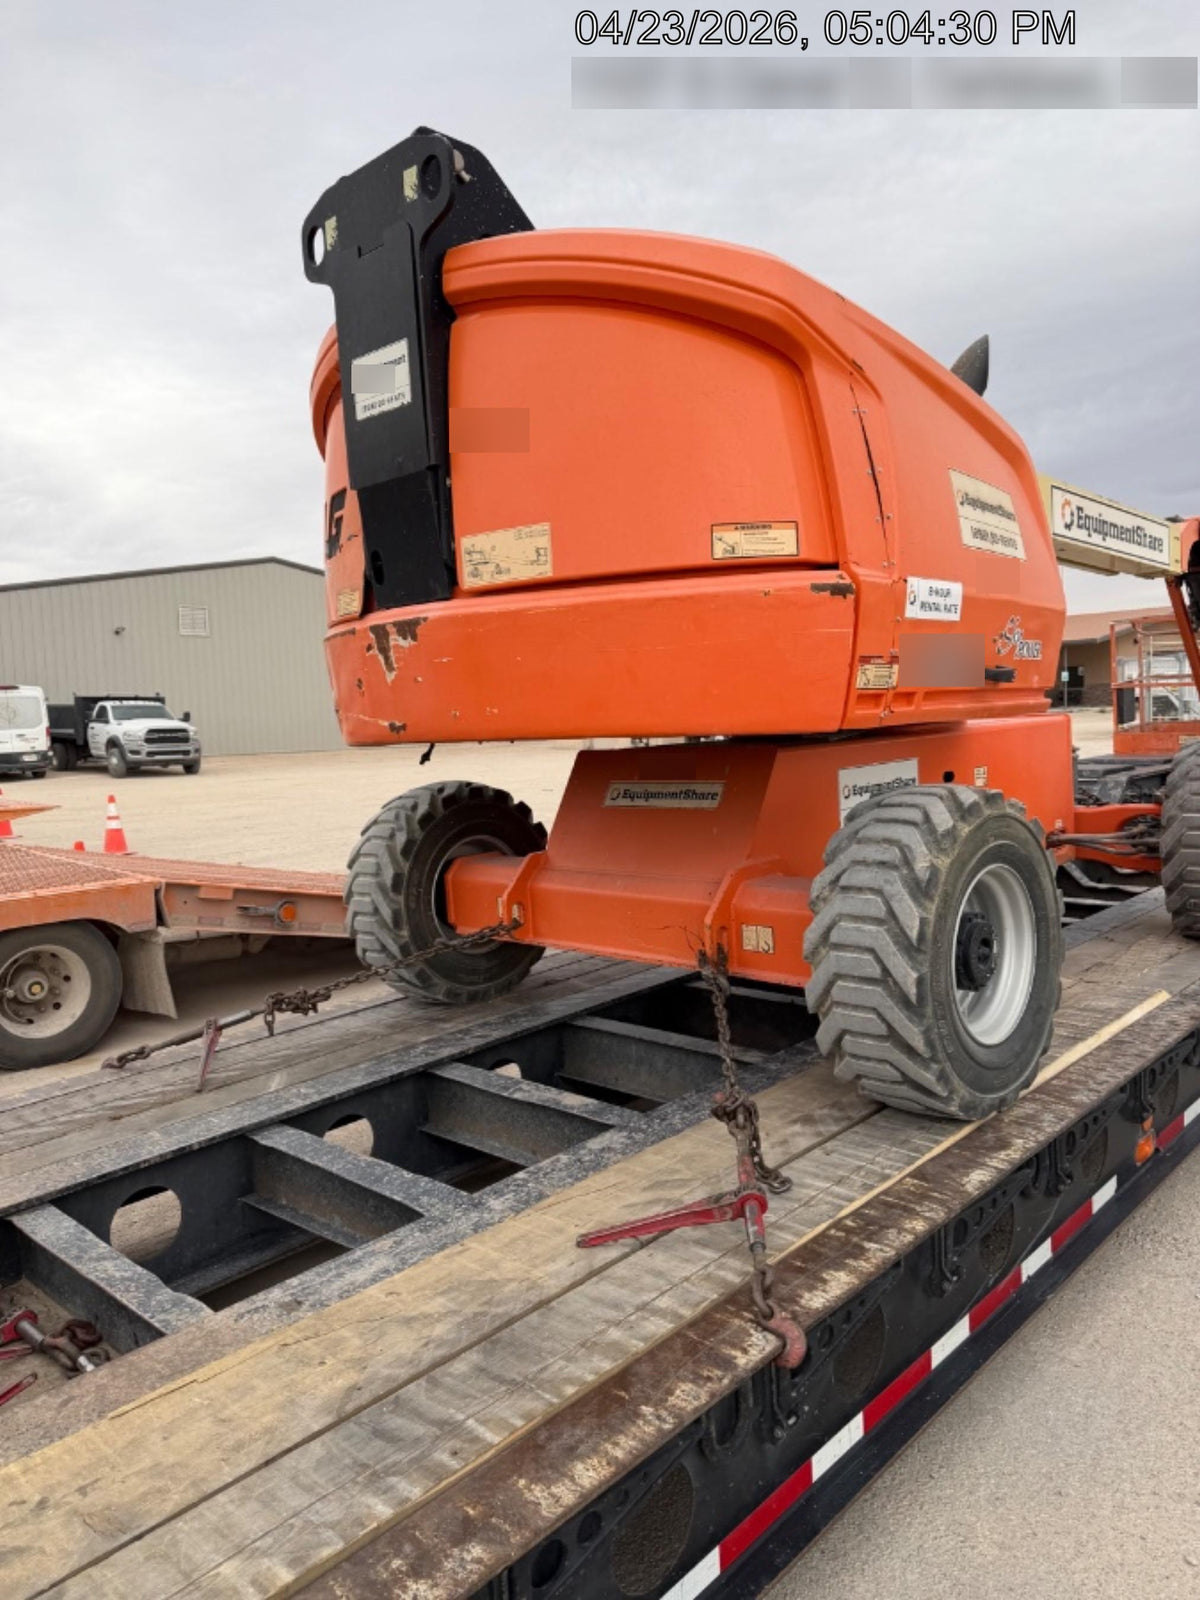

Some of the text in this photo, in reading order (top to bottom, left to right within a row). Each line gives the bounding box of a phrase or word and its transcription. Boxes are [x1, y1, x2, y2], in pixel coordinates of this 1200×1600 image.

[1076, 506, 1164, 553] EquipmentShare
[919, 601, 943, 613] RENTAL
[621, 787, 719, 802] EquipmentShare
